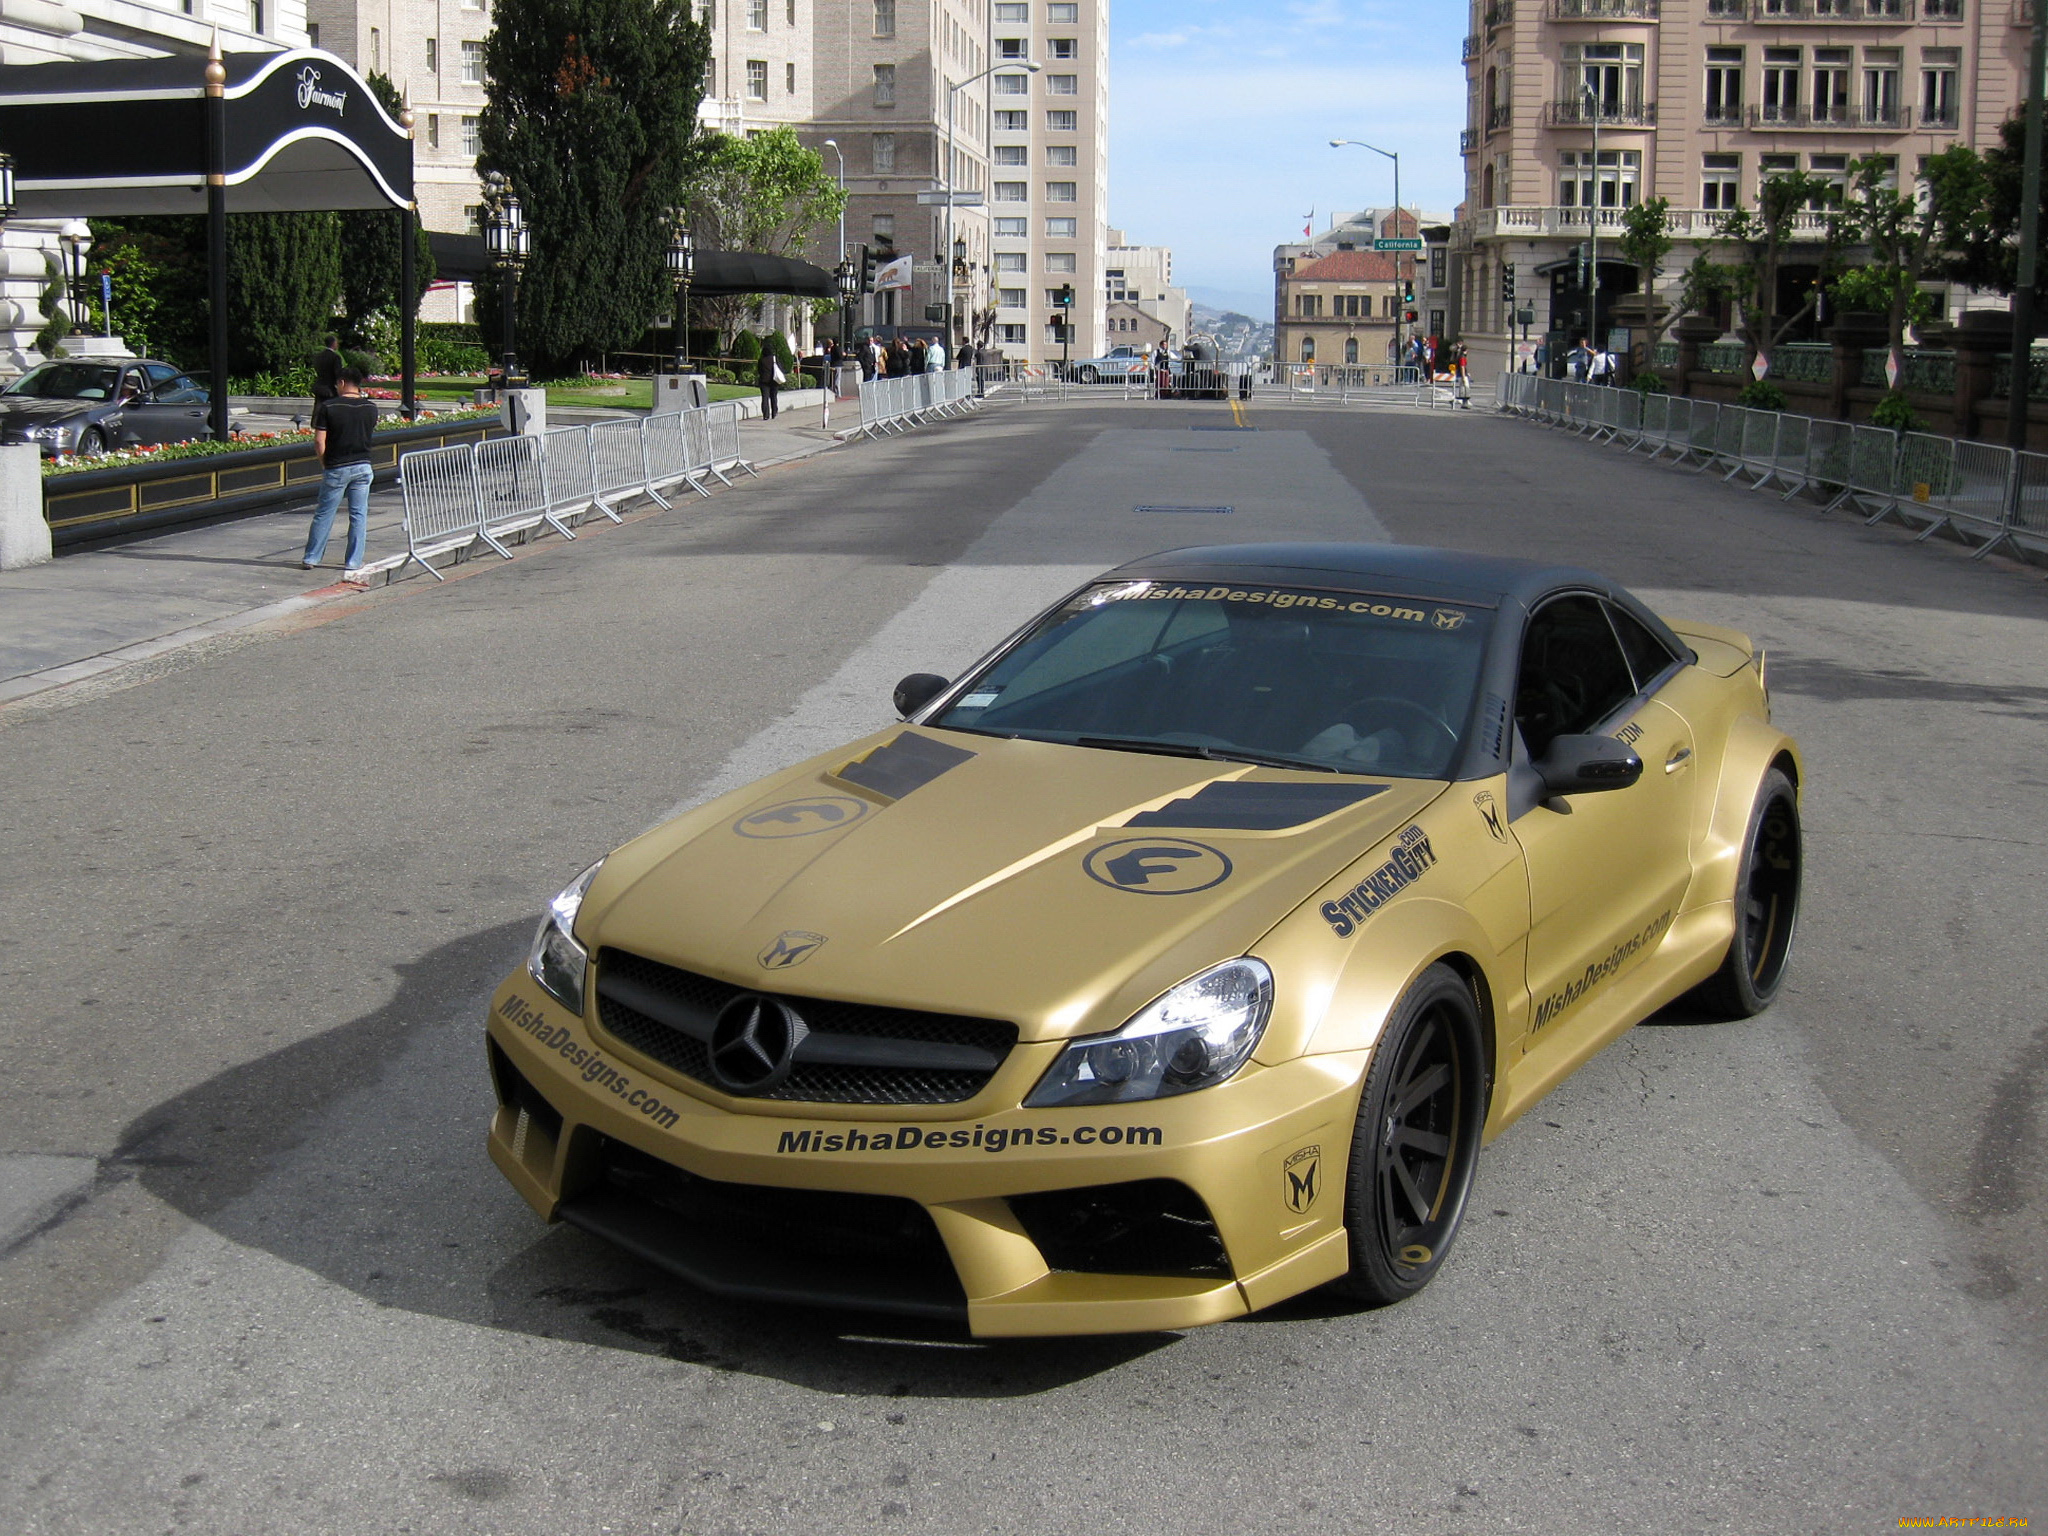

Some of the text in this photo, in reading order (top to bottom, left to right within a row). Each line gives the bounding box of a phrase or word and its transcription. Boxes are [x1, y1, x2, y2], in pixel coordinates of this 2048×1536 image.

[297, 66, 348, 117] Fairmont
[1378, 241, 1418, 249] California
[1113, 586, 1425, 622] MishaDesigns.com
[1532, 909, 1671, 1034] MishaDesigns.com
[499, 994, 680, 1130] MishaDesigns.com
[778, 1124, 1163, 1153] MishaDesigns.com
